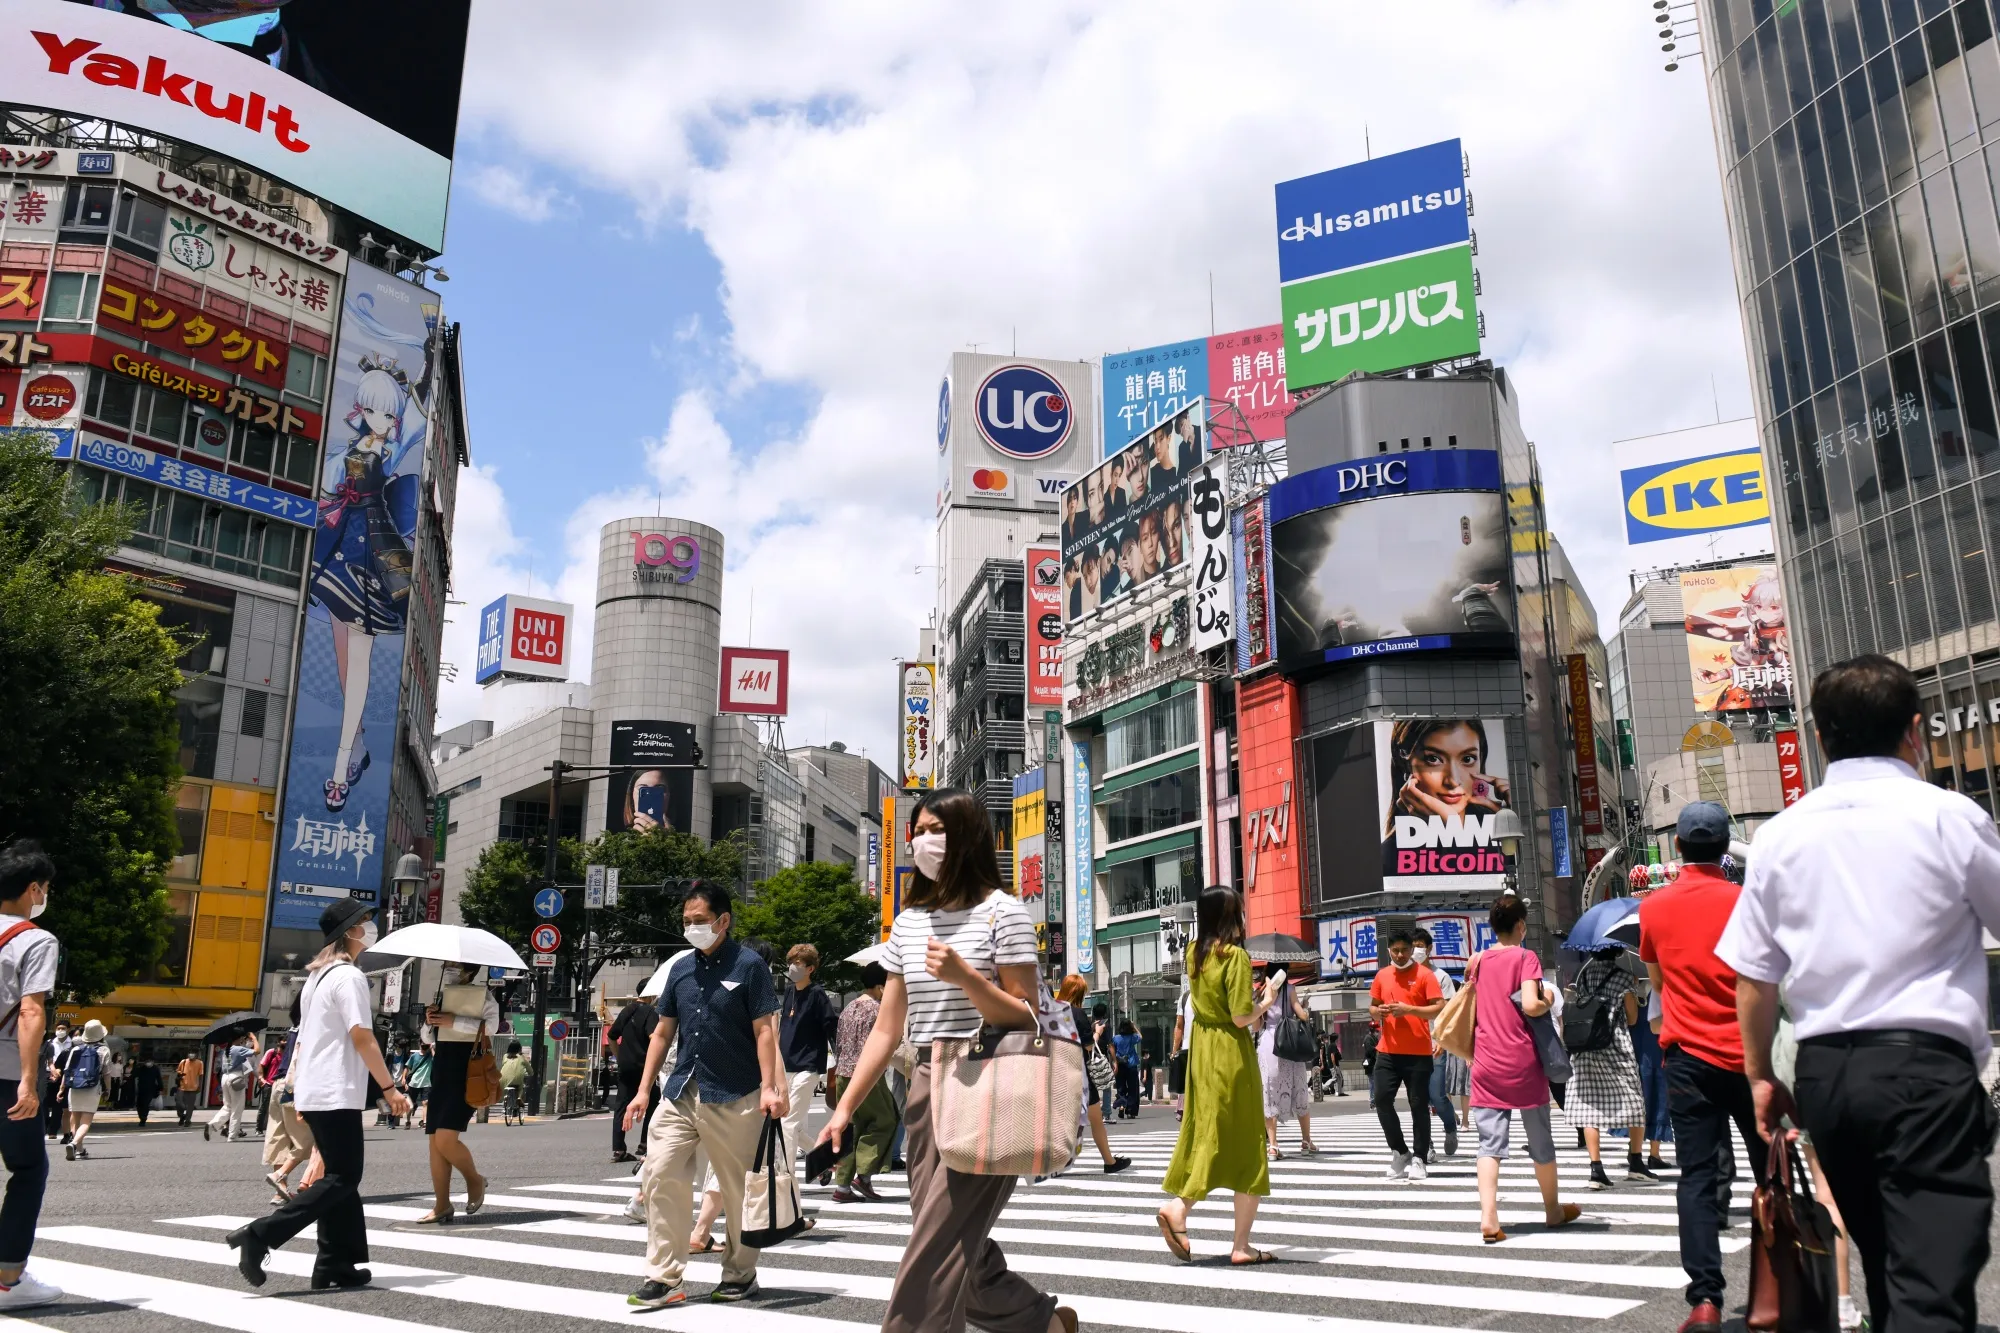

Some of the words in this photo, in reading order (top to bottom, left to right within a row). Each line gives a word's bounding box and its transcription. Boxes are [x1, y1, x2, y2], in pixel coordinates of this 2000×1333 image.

[30, 30, 311, 153] Yakult
[81, 156, 111, 171] 寿司
[157, 171, 339, 262] しゃぶしゃぶバイキング
[1280, 187, 1462, 242] Hisamitsu
[224, 243, 330, 312] しゃぶ葉
[100, 283, 282, 373] コンタクト
[1294, 280, 1464, 354] サロンパス
[29, 394, 70, 408] ガスト
[1125, 364, 1187, 401] 龍角散
[1225, 377, 1298, 410] ダイレク
[224, 388, 305, 433] ガスト
[90, 442, 146, 471] AEON
[1036, 478, 1067, 494] VIS
[1337, 460, 1407, 494] DHC
[1644, 470, 1765, 518] IKE
[630, 531, 700, 583] 109
[1065, 528, 1101, 558] SEVENTEEN
[1192, 465, 1230, 638] もんじゃ
[632, 570, 674, 583] SHIBUYA
[1683, 577, 1716, 587] miHoYo
[486, 608, 500, 640] THE
[519, 615, 556, 637] UNI
[477, 634, 502, 672] PRIME
[517, 636, 557, 658] QLO
[1351, 643, 1376, 656] DHC
[1376, 639, 1419, 653] Channel
[737, 669, 772, 693] H&M
[1571, 658, 1591, 757] クスリのことなら
[1579, 763, 1601, 826] 三千里
[289, 809, 377, 882] 原神
[1075, 770, 1089, 887] サマーフルーツギフト
[296, 859, 346, 872] Genshin
[884, 849, 892, 896] Matsumoto
[1396, 848, 1504, 874] Bitcoin
[297, 884, 314, 894] 原神
[593, 868, 603, 905] 渋谷駅前
[427, 895, 439, 921] アコム
[1328, 920, 1499, 964] 大盛書店
